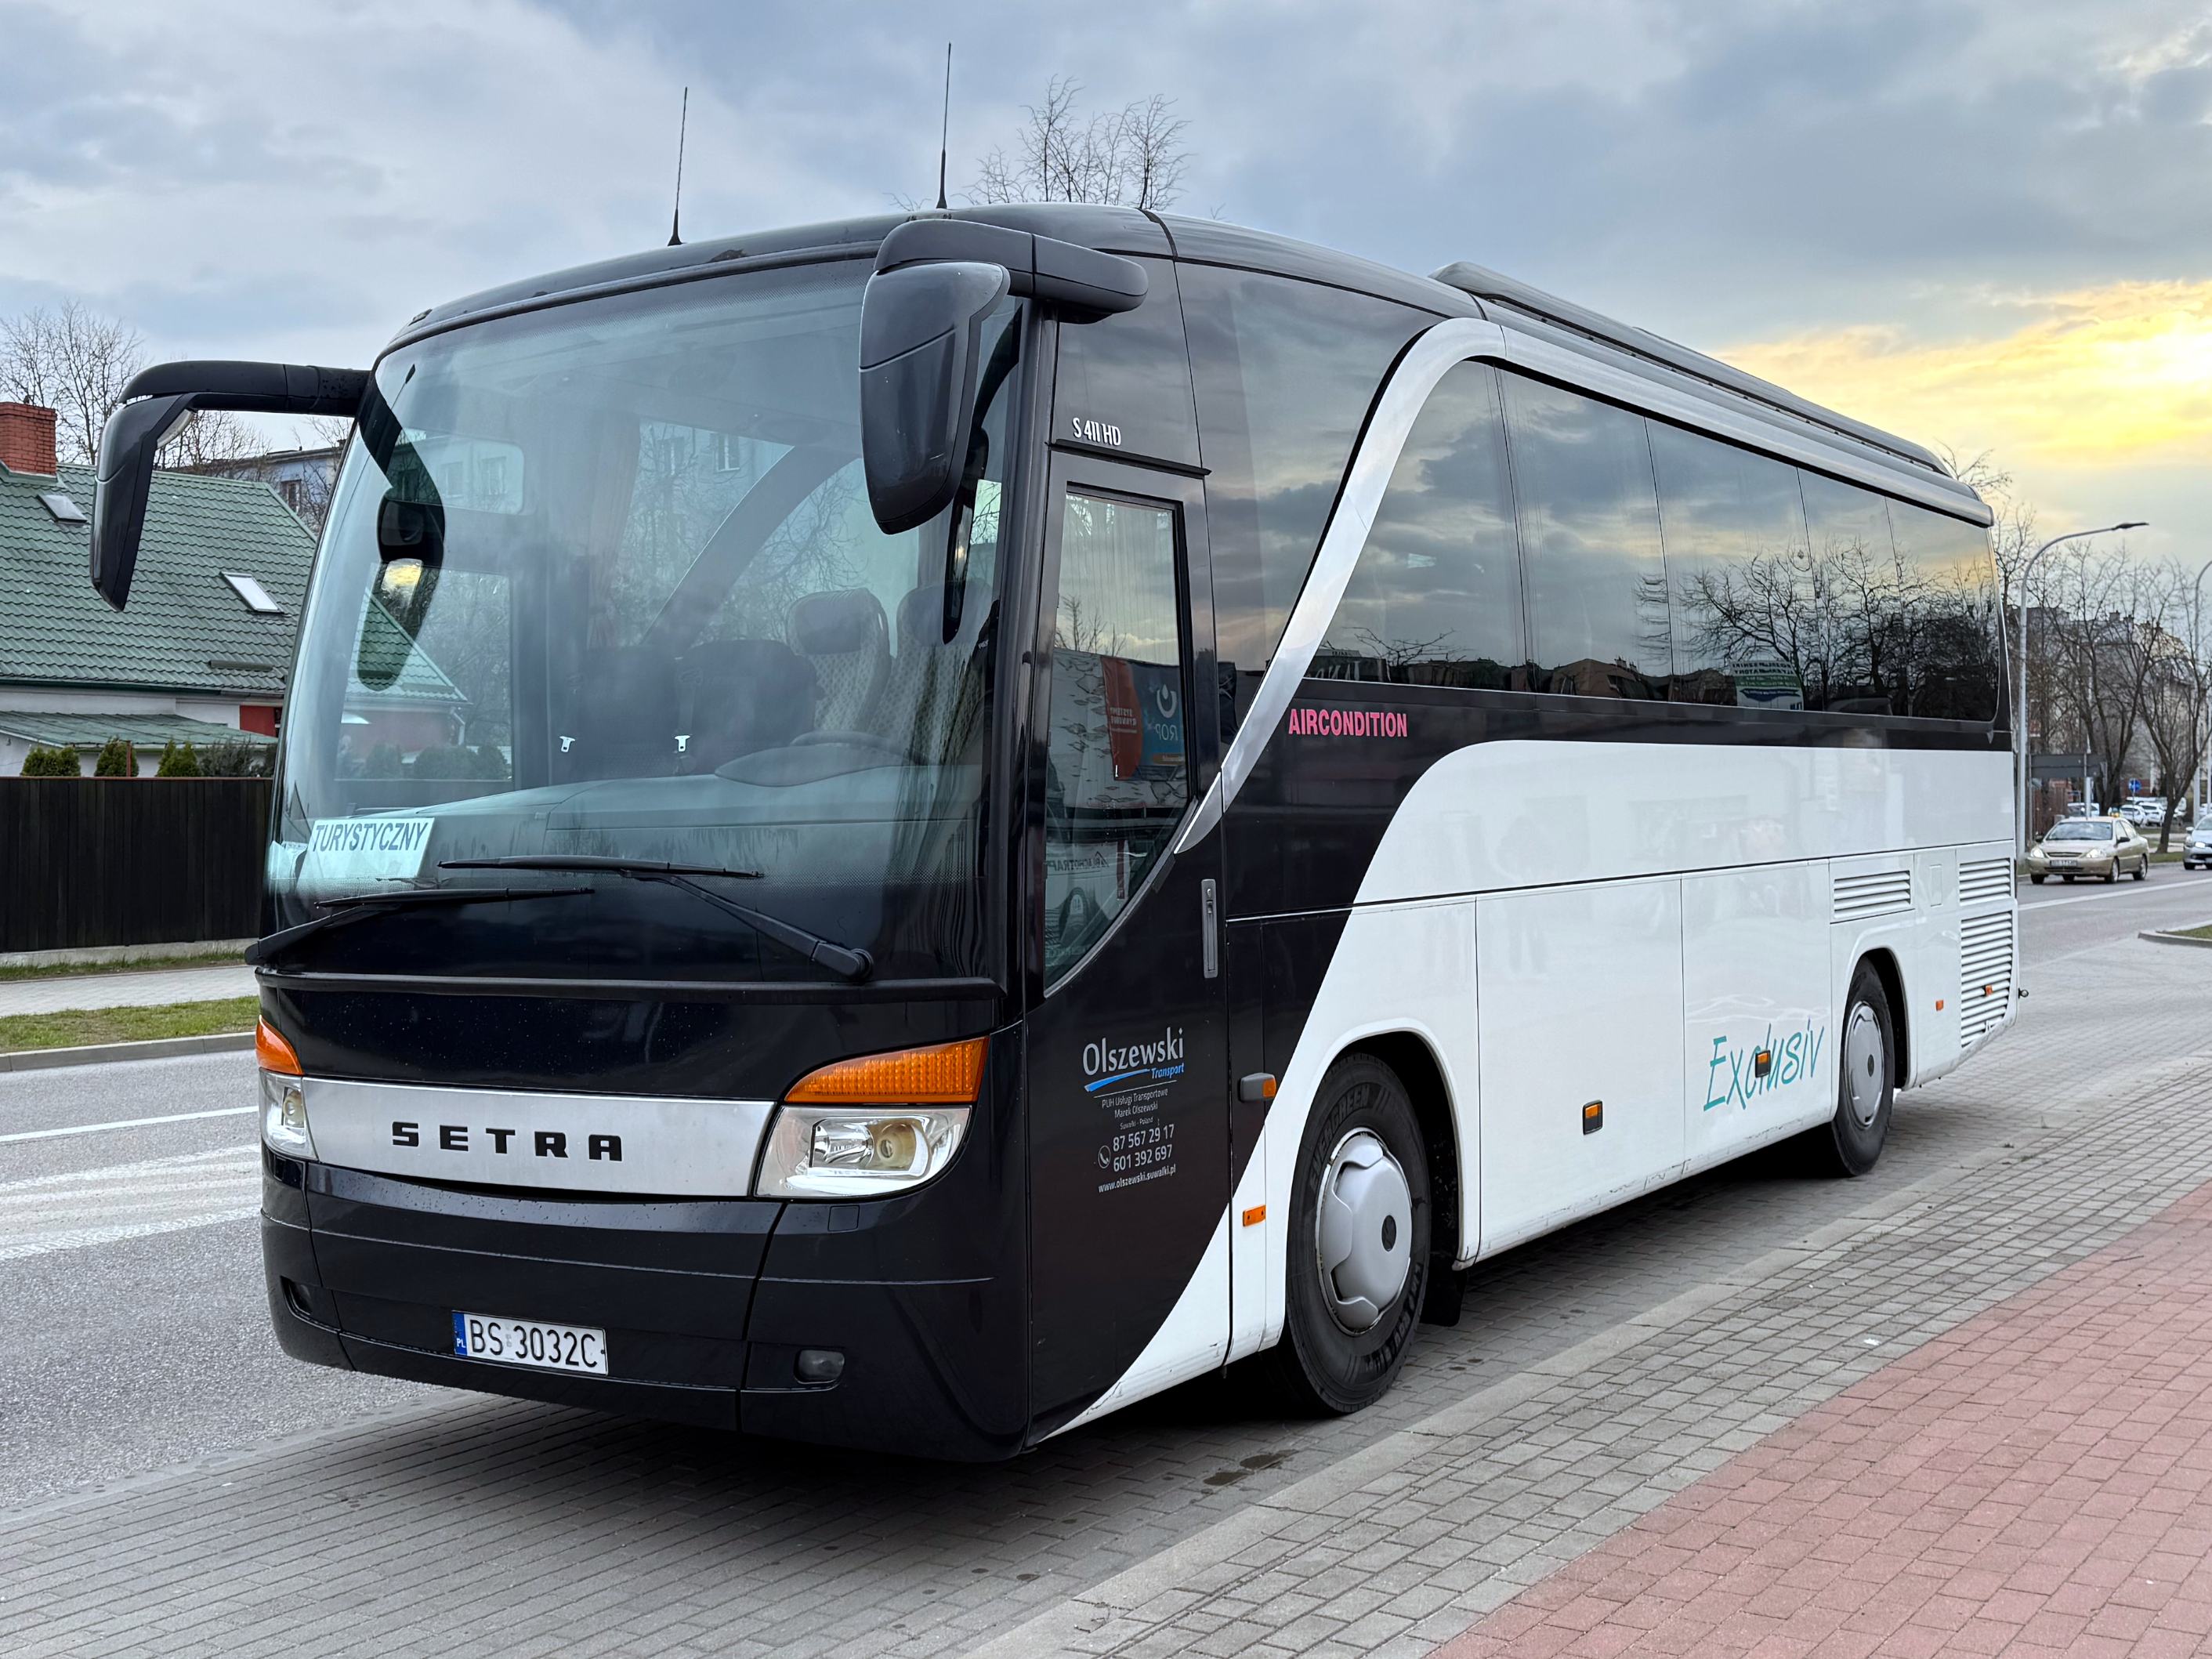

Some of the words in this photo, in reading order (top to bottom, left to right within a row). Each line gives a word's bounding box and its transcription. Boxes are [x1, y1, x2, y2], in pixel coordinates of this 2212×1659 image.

[1072, 417, 1082, 438] S
[1084, 420, 1100, 443] 411
[1101, 423, 1121, 446] HD
[1288, 708, 1408, 737] AIRCONDITION
[312, 822, 429, 852] TURYSTYCZNY
[1083, 1027, 1183, 1076] Olszewski
[1703, 1016, 1825, 1111] Exclusiv
[1151, 1063, 1185, 1079] Transport
[1102, 1099, 1115, 1109] PUH
[1133, 1088, 1168, 1102] Transportowe
[1114, 1107, 1131, 1118] Marek
[1132, 1100, 1158, 1114] Olszewski
[392, 1121, 623, 1162] SETRA
[1113, 1135, 1126, 1152] 87
[1128, 1130, 1146, 1148] 567
[1149, 1127, 1160, 1143] 29
[1163, 1124, 1175, 1139] 17
[1309, 1085, 1370, 1189] EVERGREEN
[1113, 1154, 1131, 1172] 601
[1135, 1149, 1153, 1167] 392
[1155, 1144, 1172, 1161] 697
[456, 1338, 466, 1349] PL
[469, 1320, 503, 1356] BS
[513, 1325, 598, 1368] 3032C
